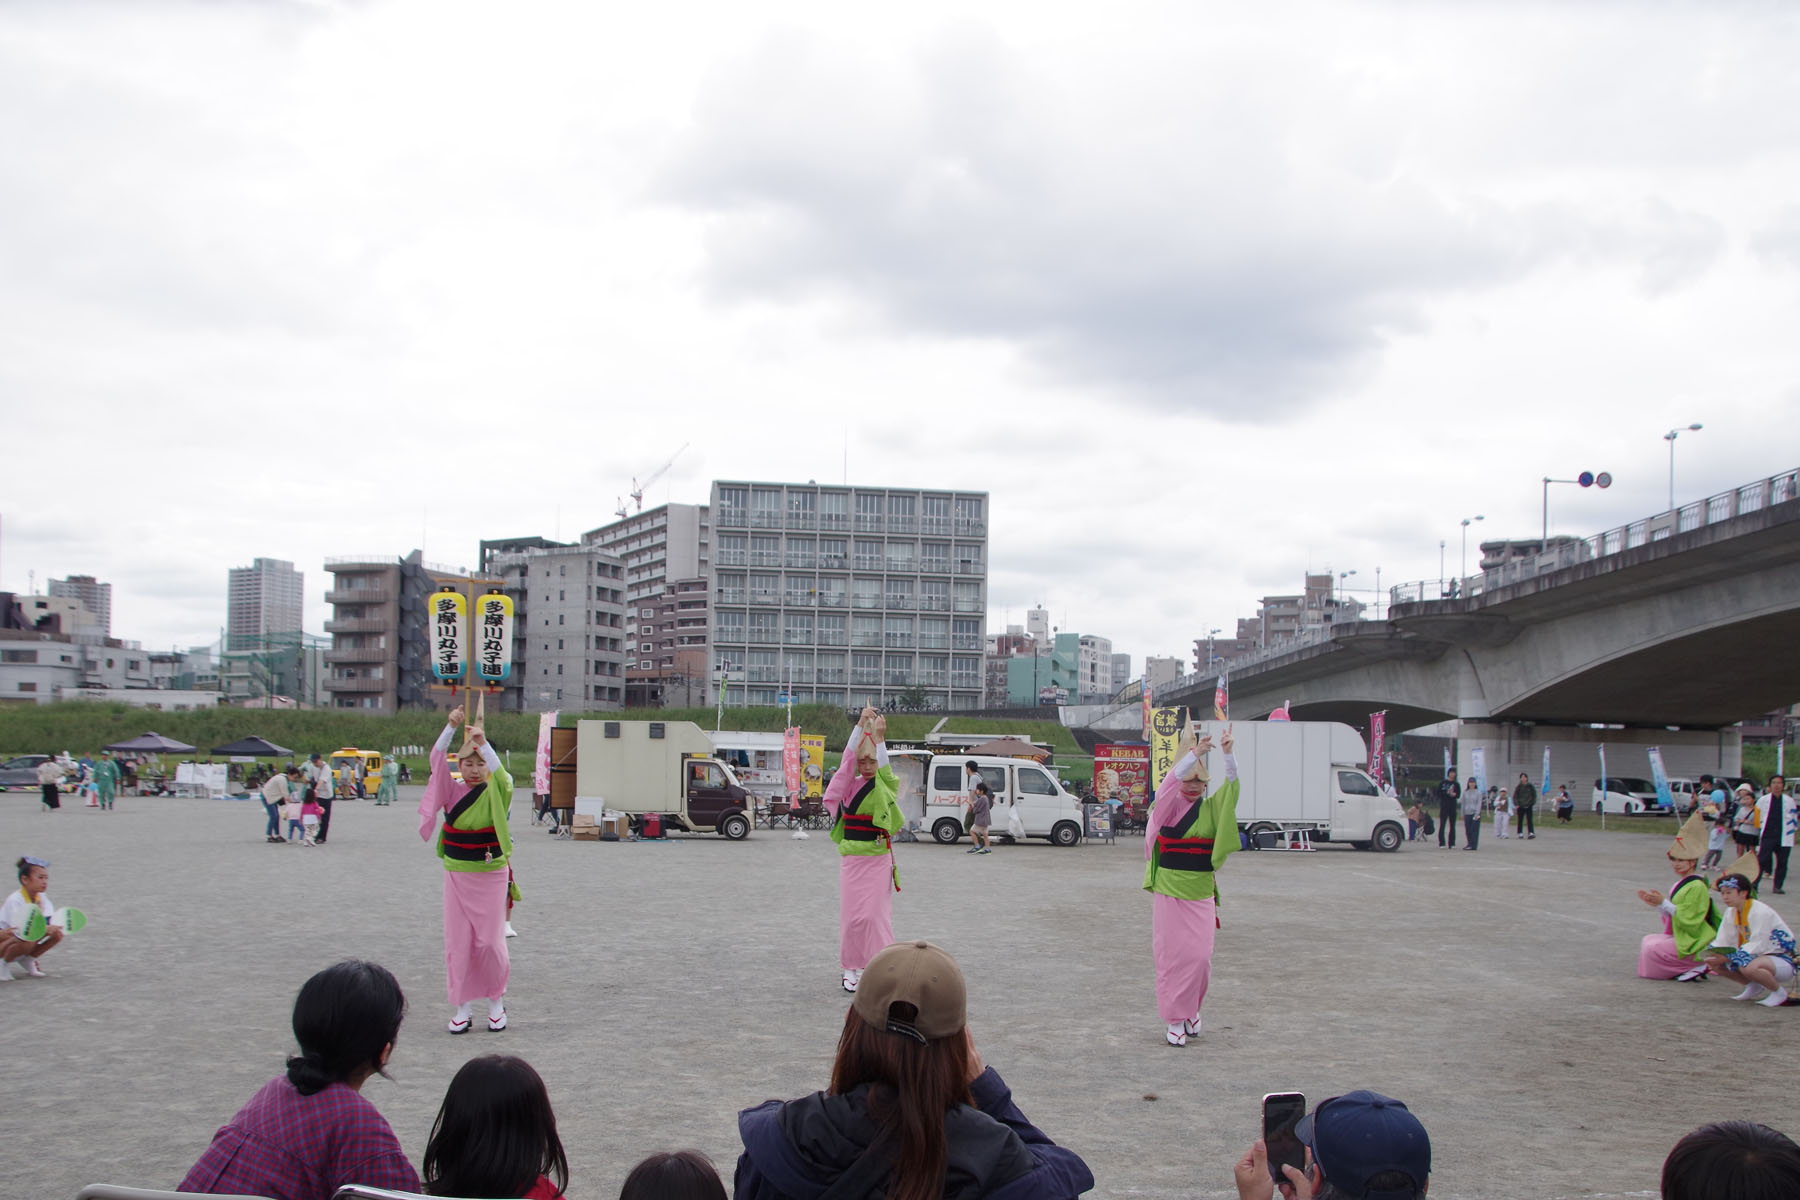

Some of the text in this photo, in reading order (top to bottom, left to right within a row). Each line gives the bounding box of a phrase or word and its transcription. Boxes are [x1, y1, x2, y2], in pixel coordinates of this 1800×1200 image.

[437, 599, 459, 675] 多摩川丸子連
[483, 601, 504, 676] 多摩川丸子連
[1112, 750, 1145, 758] KEBAB
